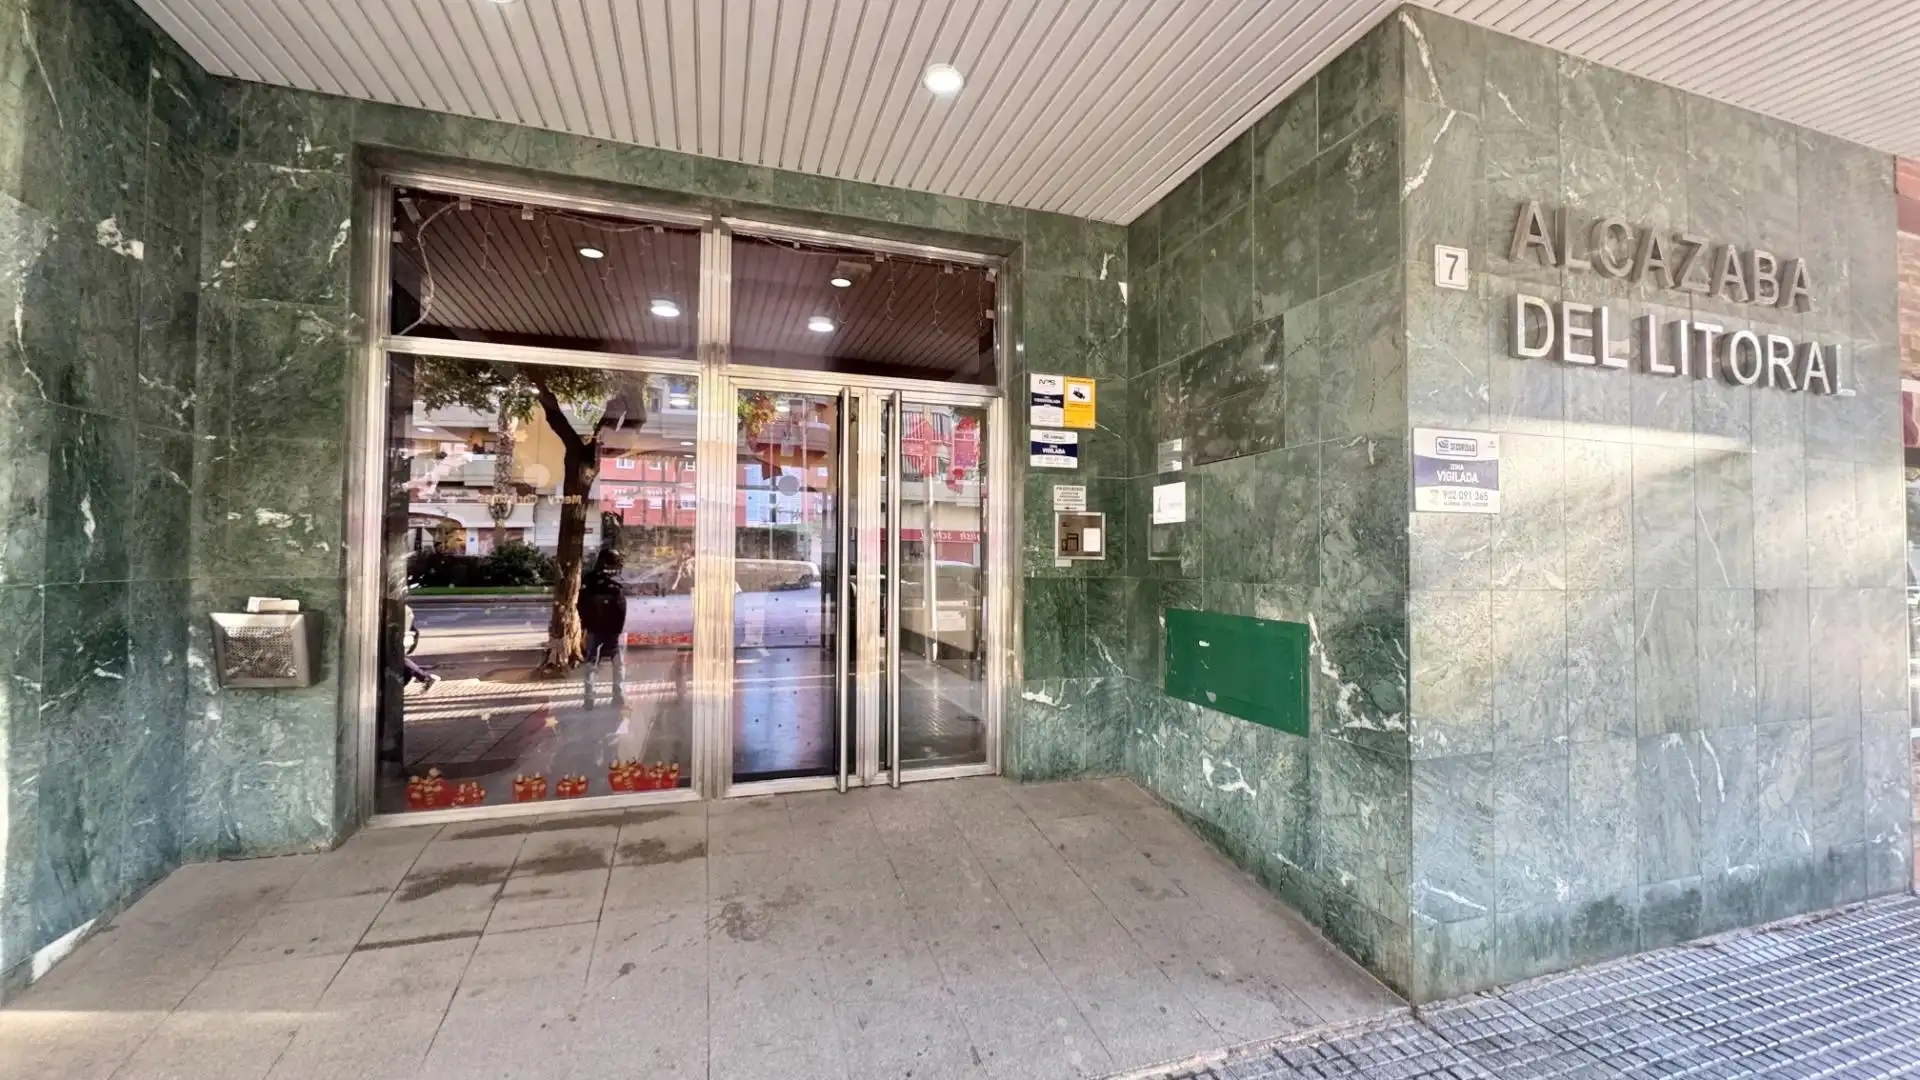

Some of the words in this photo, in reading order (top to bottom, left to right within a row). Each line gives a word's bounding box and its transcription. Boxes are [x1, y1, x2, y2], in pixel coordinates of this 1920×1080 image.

[1444, 253, 1459, 281] 7
[1509, 200, 1816, 313] ALCAZABA
[1510, 292, 1629, 369] DEL
[1635, 312, 1857, 397] LITORAL
[1437, 469, 1479, 483] VIGILADA
[1458, 490, 1472, 501] 091
